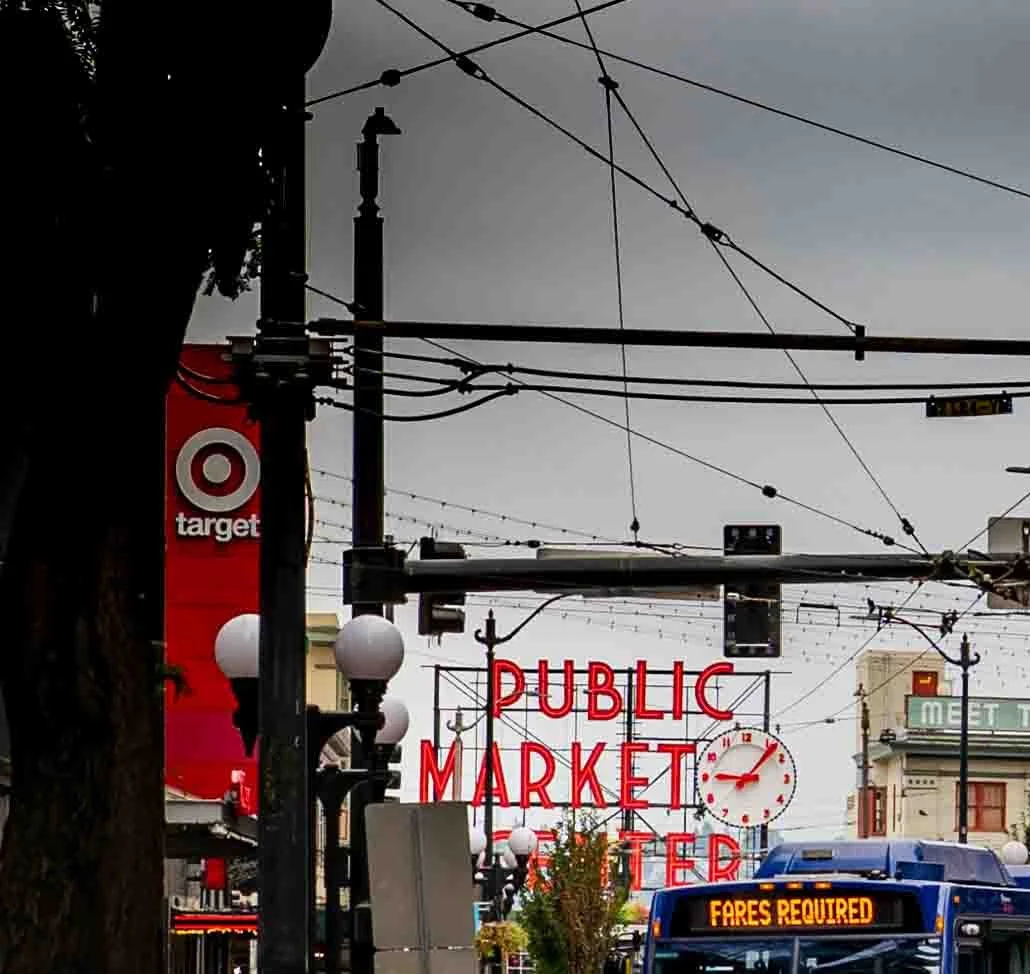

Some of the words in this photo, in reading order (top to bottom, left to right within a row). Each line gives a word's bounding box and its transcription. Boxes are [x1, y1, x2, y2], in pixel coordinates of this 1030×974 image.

[176, 512, 261, 542] target
[493, 659, 735, 720] PUBLIC
[920, 701, 1000, 728] MEET
[420, 739, 698, 809] MARKET
[709, 900, 772, 927] FARES
[777, 897, 873, 925] REQUIRED
